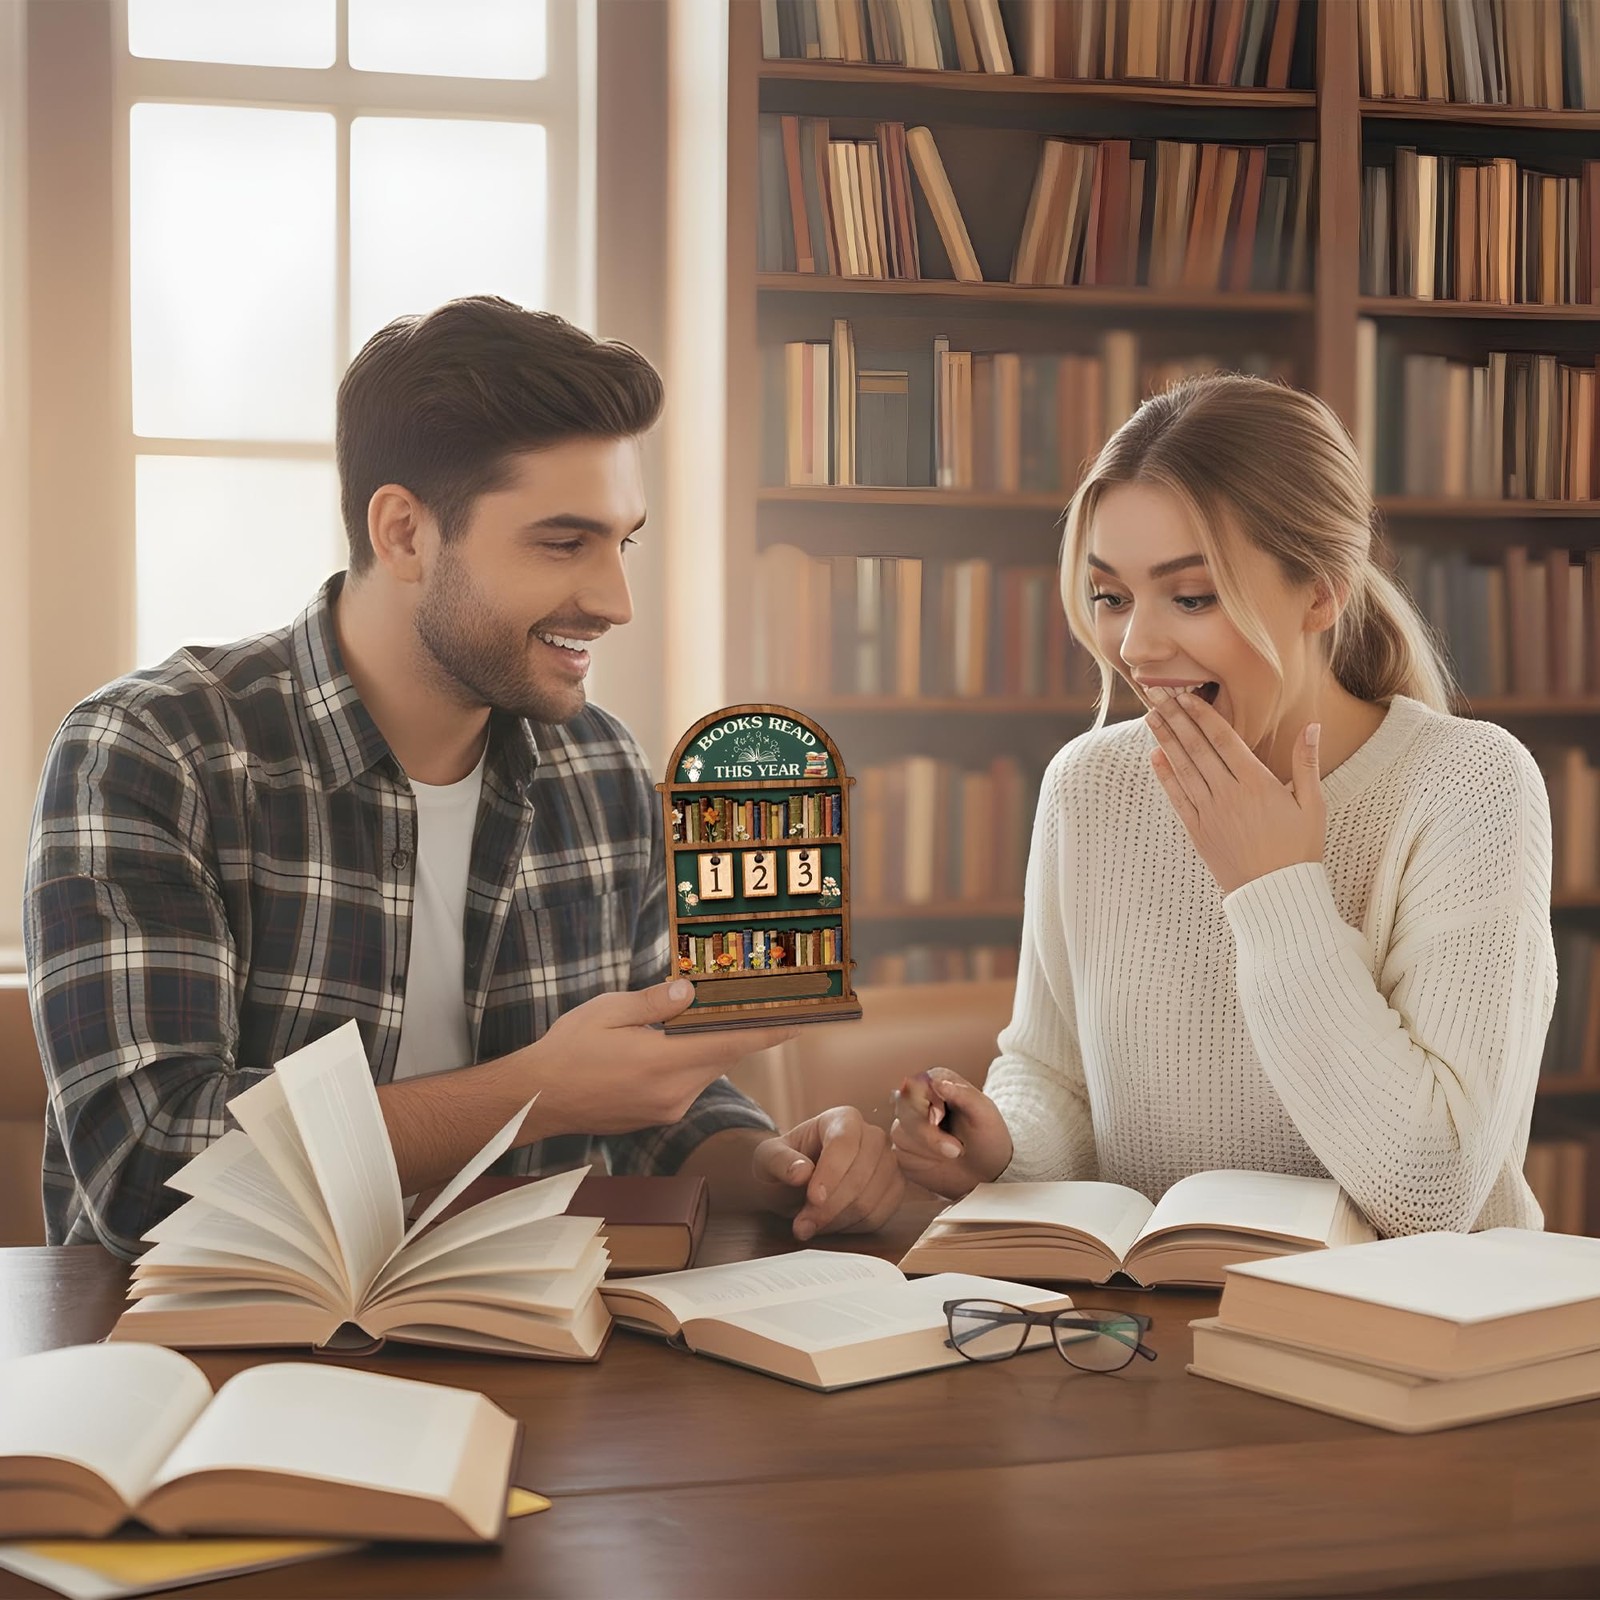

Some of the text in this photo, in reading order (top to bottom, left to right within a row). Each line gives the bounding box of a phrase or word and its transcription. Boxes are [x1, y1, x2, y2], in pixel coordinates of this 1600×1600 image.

[697, 716, 816, 751] BOOKS READ
[714, 763, 800, 778] THIS YEAR
[710, 862, 813, 893] 1 2 3
